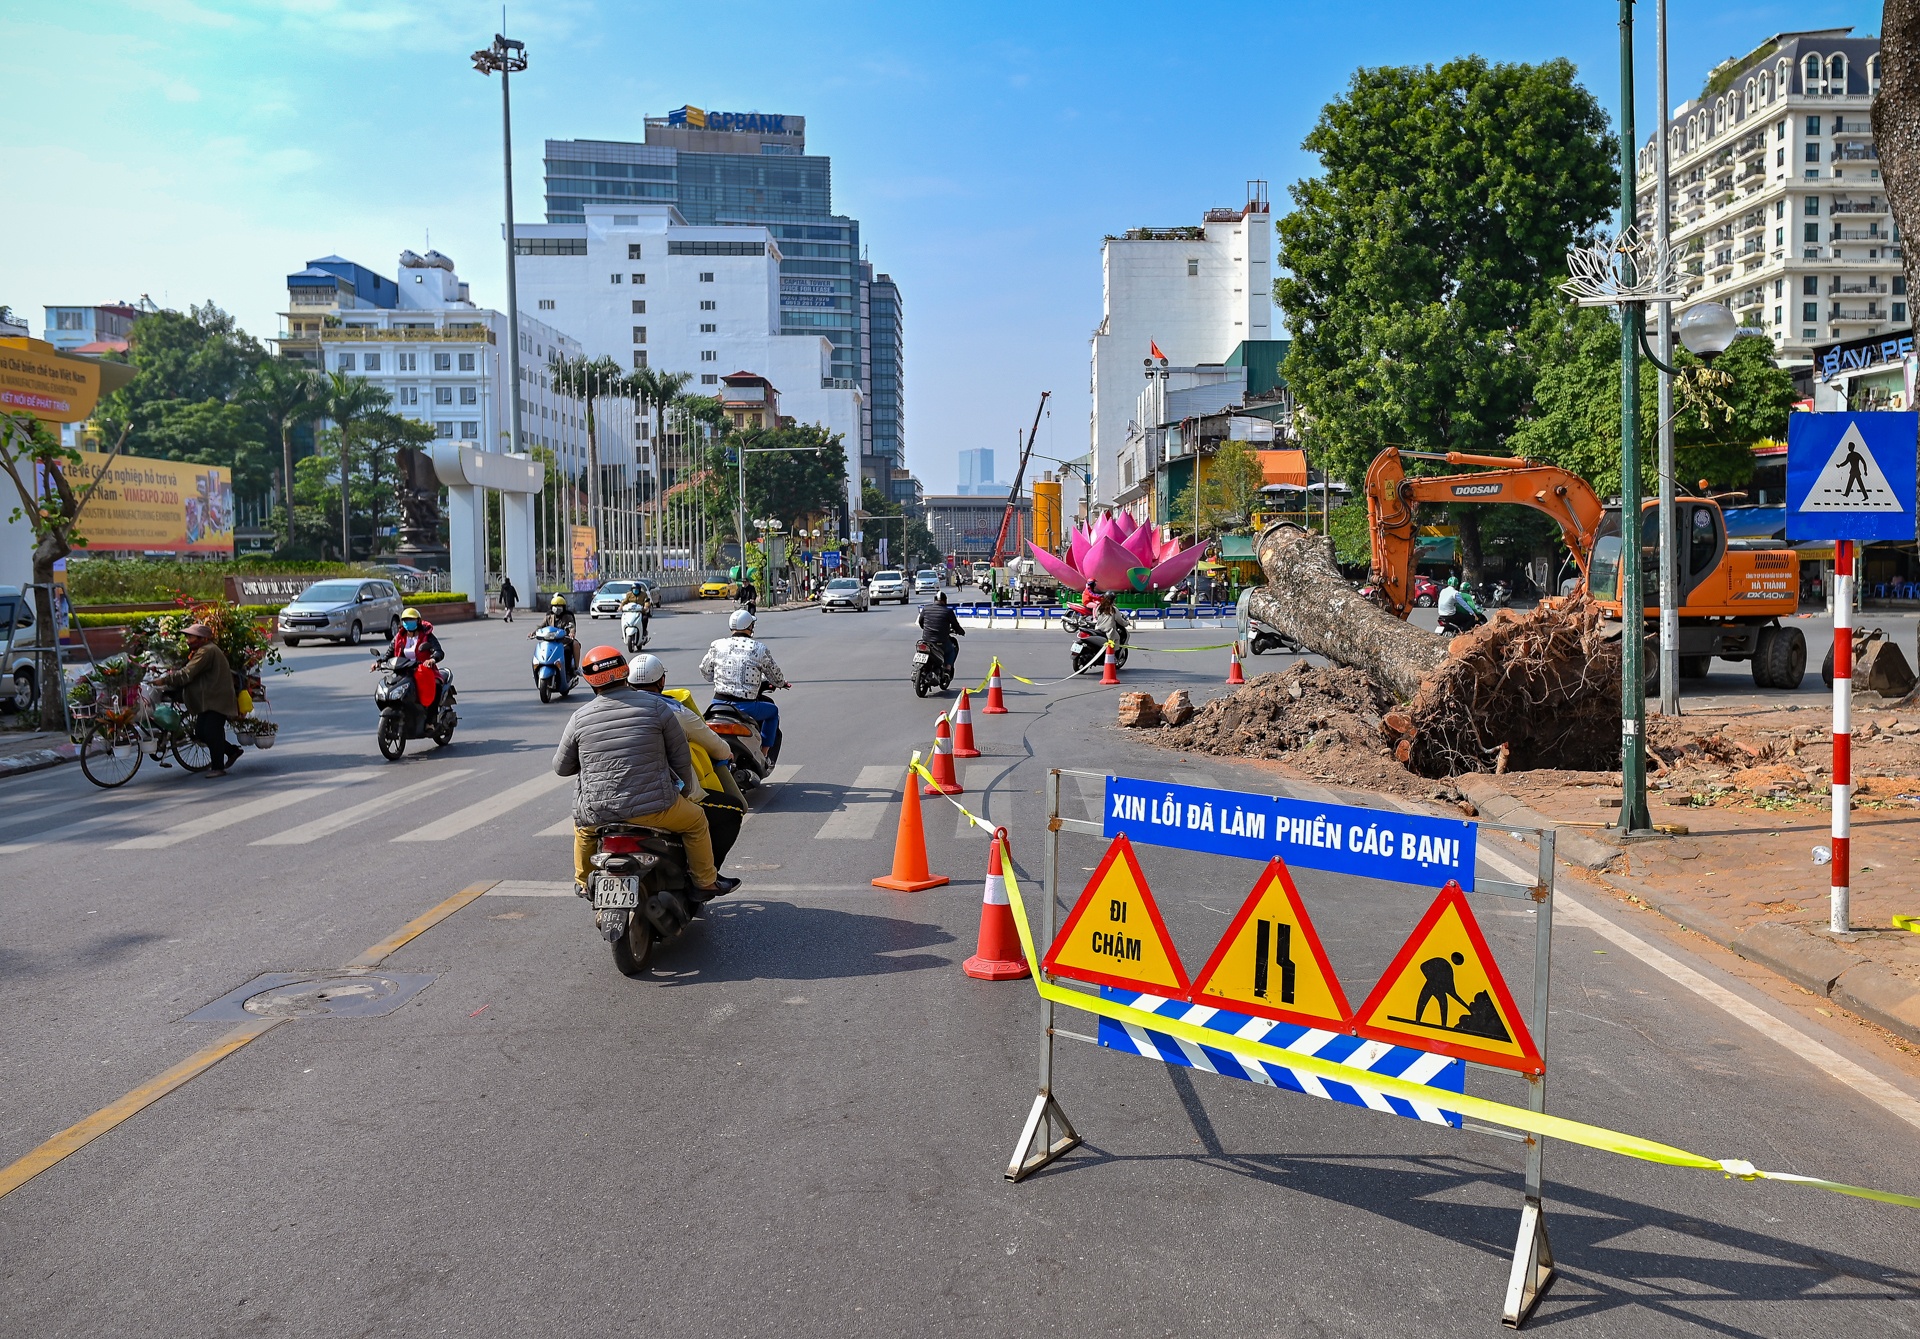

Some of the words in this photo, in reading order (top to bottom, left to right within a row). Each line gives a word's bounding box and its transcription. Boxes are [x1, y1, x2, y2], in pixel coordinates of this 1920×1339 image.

[709, 111, 785, 132] GPBANK
[97, 486, 118, 501] Nam
[123, 488, 159, 504] VIMEXPO
[160, 490, 178, 505] 2020
[1455, 485, 1499, 495] DOOSAN
[1751, 580, 1761, 590] HÀ
[1763, 580, 1787, 590] THÀNH
[1056, 588, 1165, 604] Viebank
[1111, 793, 1146, 822] XIN
[1150, 791, 1182, 828] LỖI
[1186, 802, 1215, 832] ĐÃ
[1220, 805, 1266, 840] LÀM
[1275, 814, 1342, 850] PHIỀN
[1348, 822, 1395, 858] CÁC
[1400, 832, 1460, 869] BẠN!
[598, 892, 635, 906] 144.79
[1110, 899, 1127, 923] ĐI
[1092, 931, 1142, 963] CHẬM
